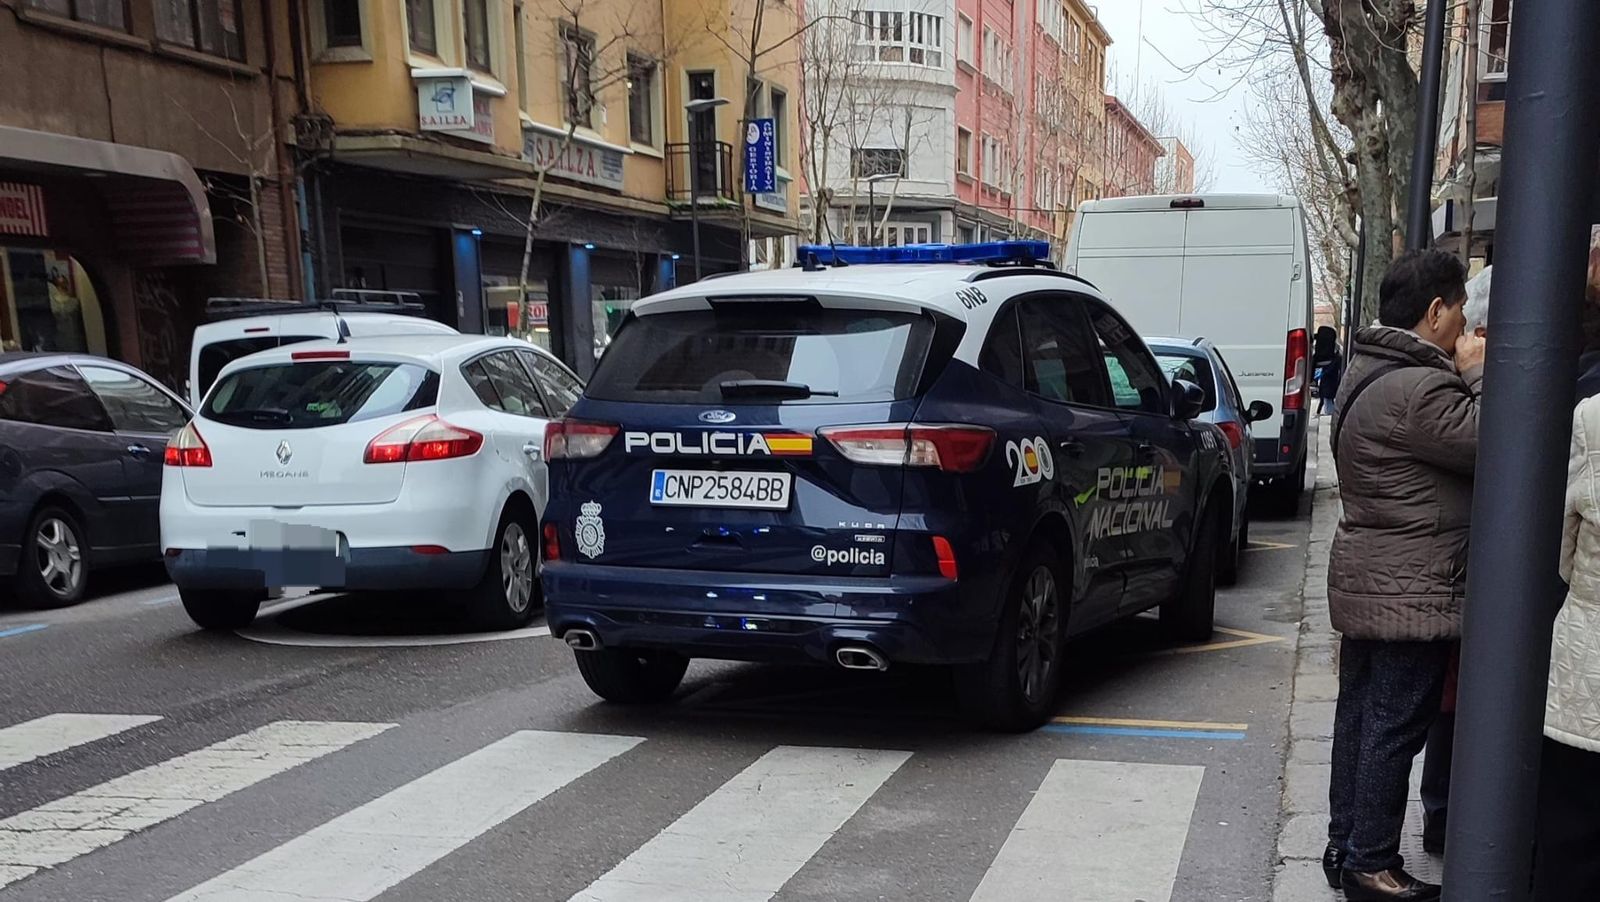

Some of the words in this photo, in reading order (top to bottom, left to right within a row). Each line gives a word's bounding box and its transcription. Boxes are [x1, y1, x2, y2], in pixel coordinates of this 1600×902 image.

[955, 286, 988, 310] 6NB
[1005, 435, 1054, 488] 200
[665, 475, 784, 502] CNP2584BB
[1089, 500, 1173, 541] NACIONAL
[811, 545, 885, 566] @policia
